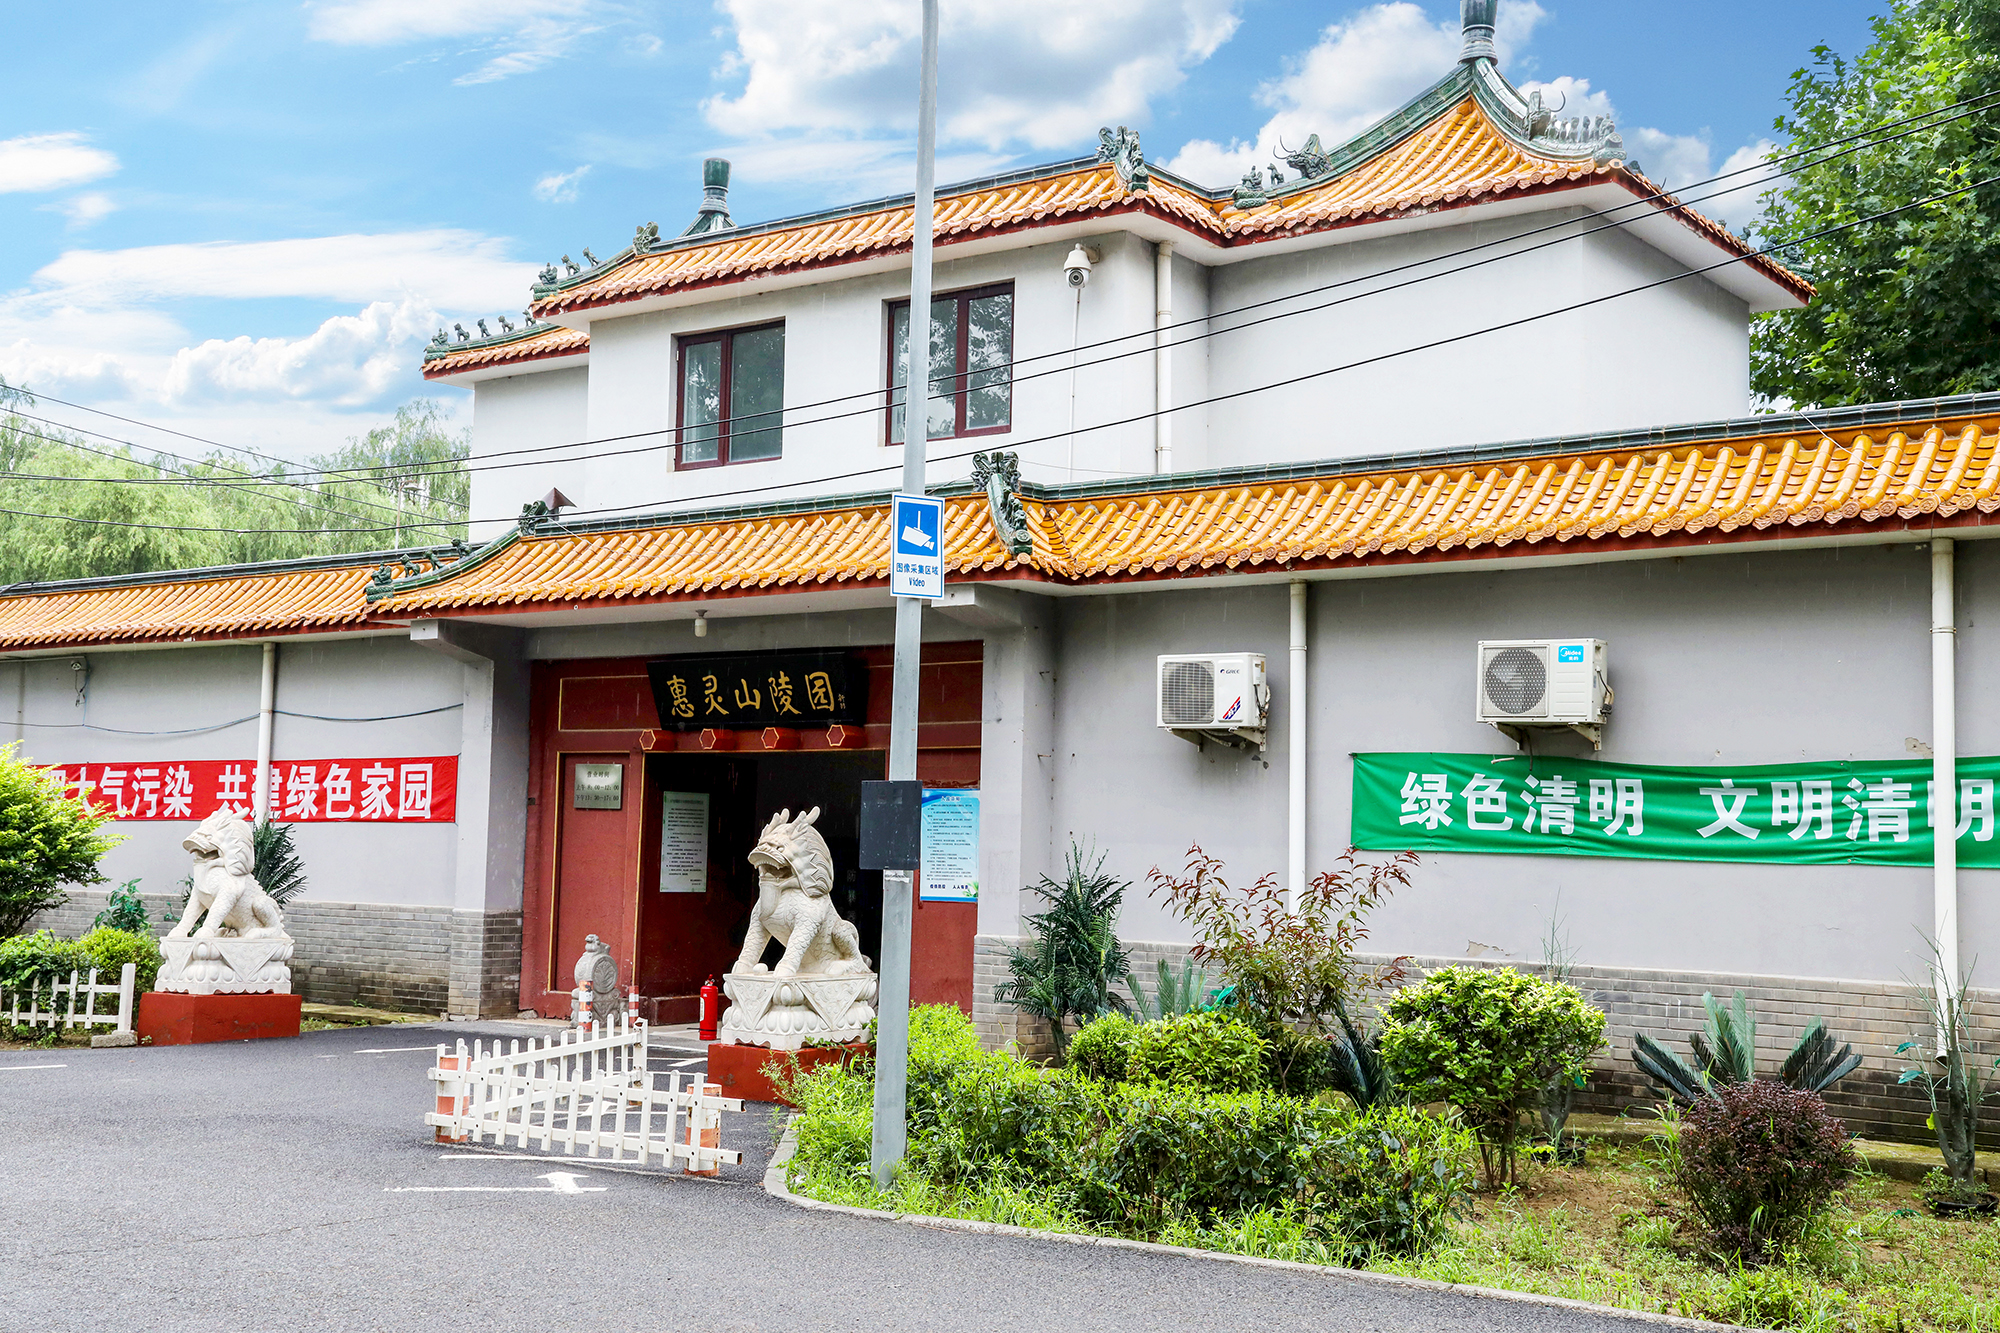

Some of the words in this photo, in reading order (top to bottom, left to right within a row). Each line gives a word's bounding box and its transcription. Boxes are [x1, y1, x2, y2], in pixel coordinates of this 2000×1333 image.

[896, 563, 939, 576] 图像采集区域
[909, 577, 925, 587] Video
[666, 670, 835, 718] 惠灵山陵园
[216, 762, 433, 819] 共建绿色家园
[1398, 772, 1644, 837] 绿色清明
[1696, 777, 1994, 842] 文明清明
